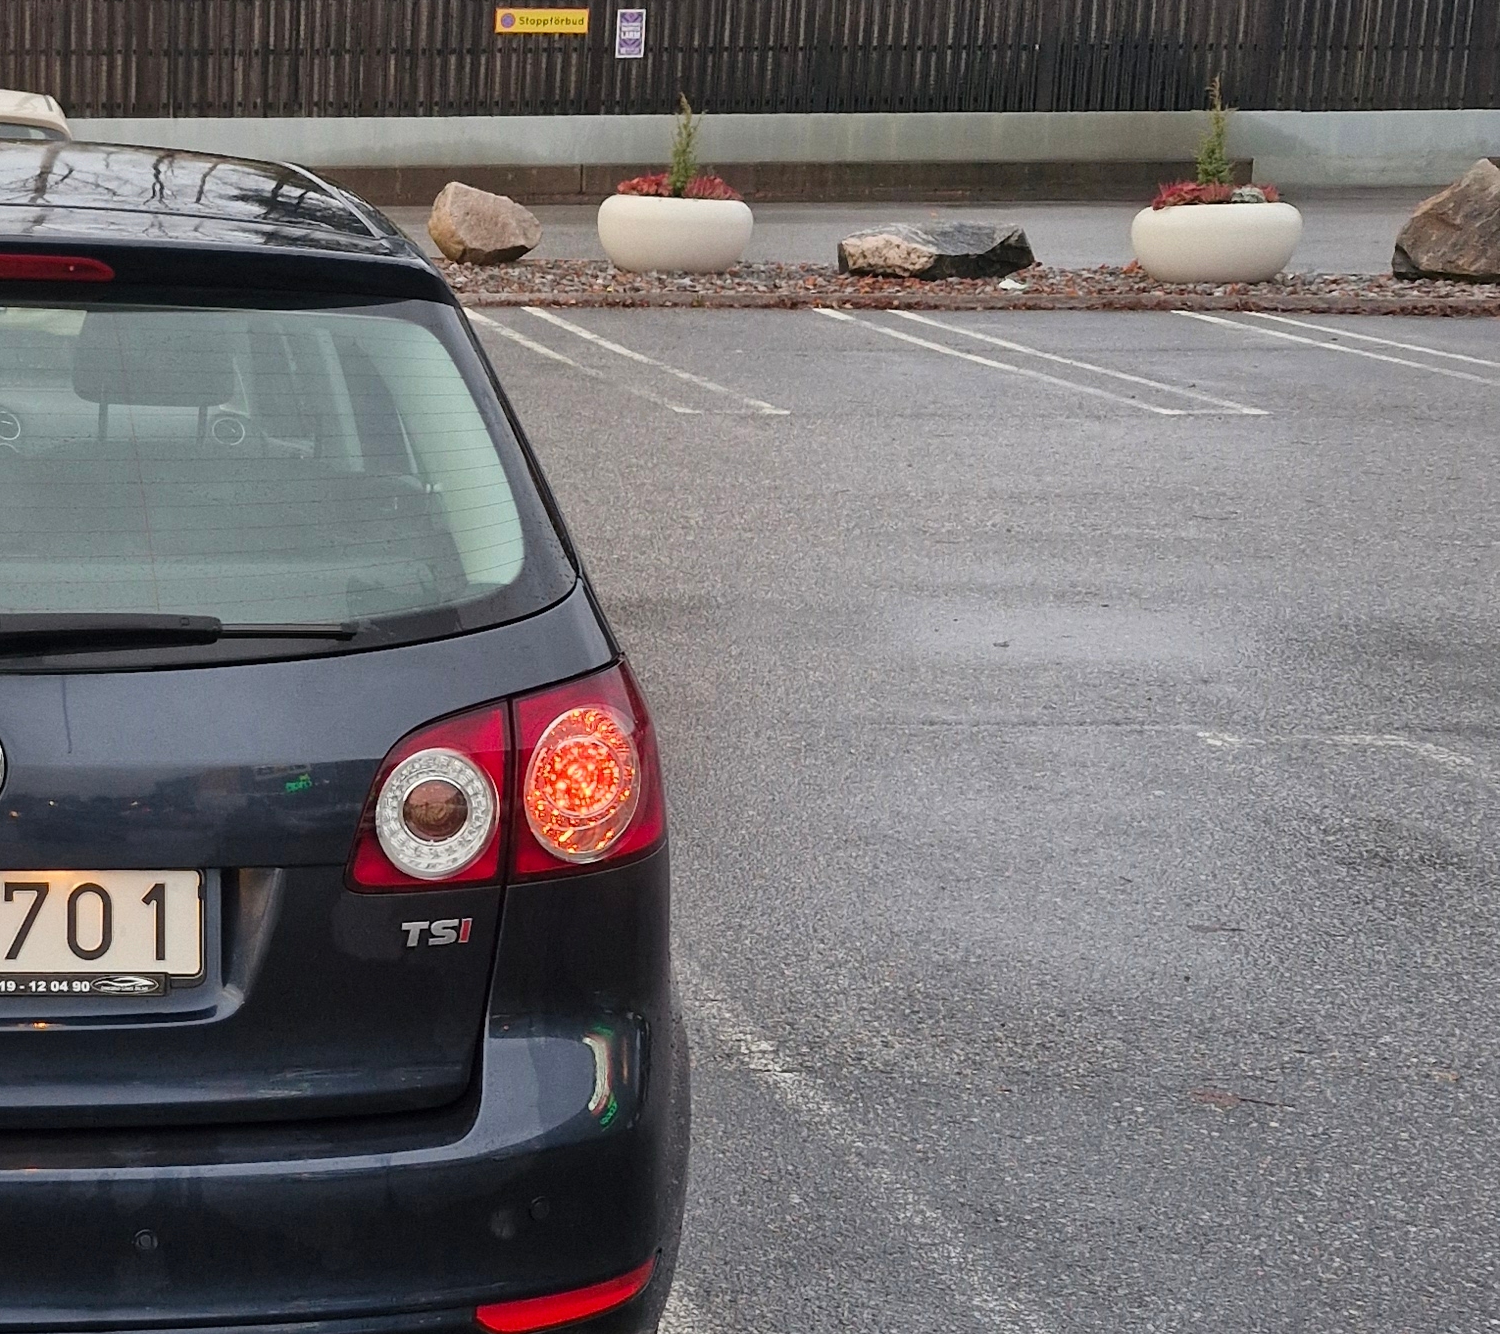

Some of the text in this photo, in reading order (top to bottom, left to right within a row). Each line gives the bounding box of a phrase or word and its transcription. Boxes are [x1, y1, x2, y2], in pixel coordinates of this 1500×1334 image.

[519, 16, 584, 27] Stoppförbud
[3, 882, 167, 961] 701
[401, 917, 473, 947] TSI
[29, 980, 47, 992] 12
[50, 980, 68, 992] 04
[72, 980, 90, 992] 90
